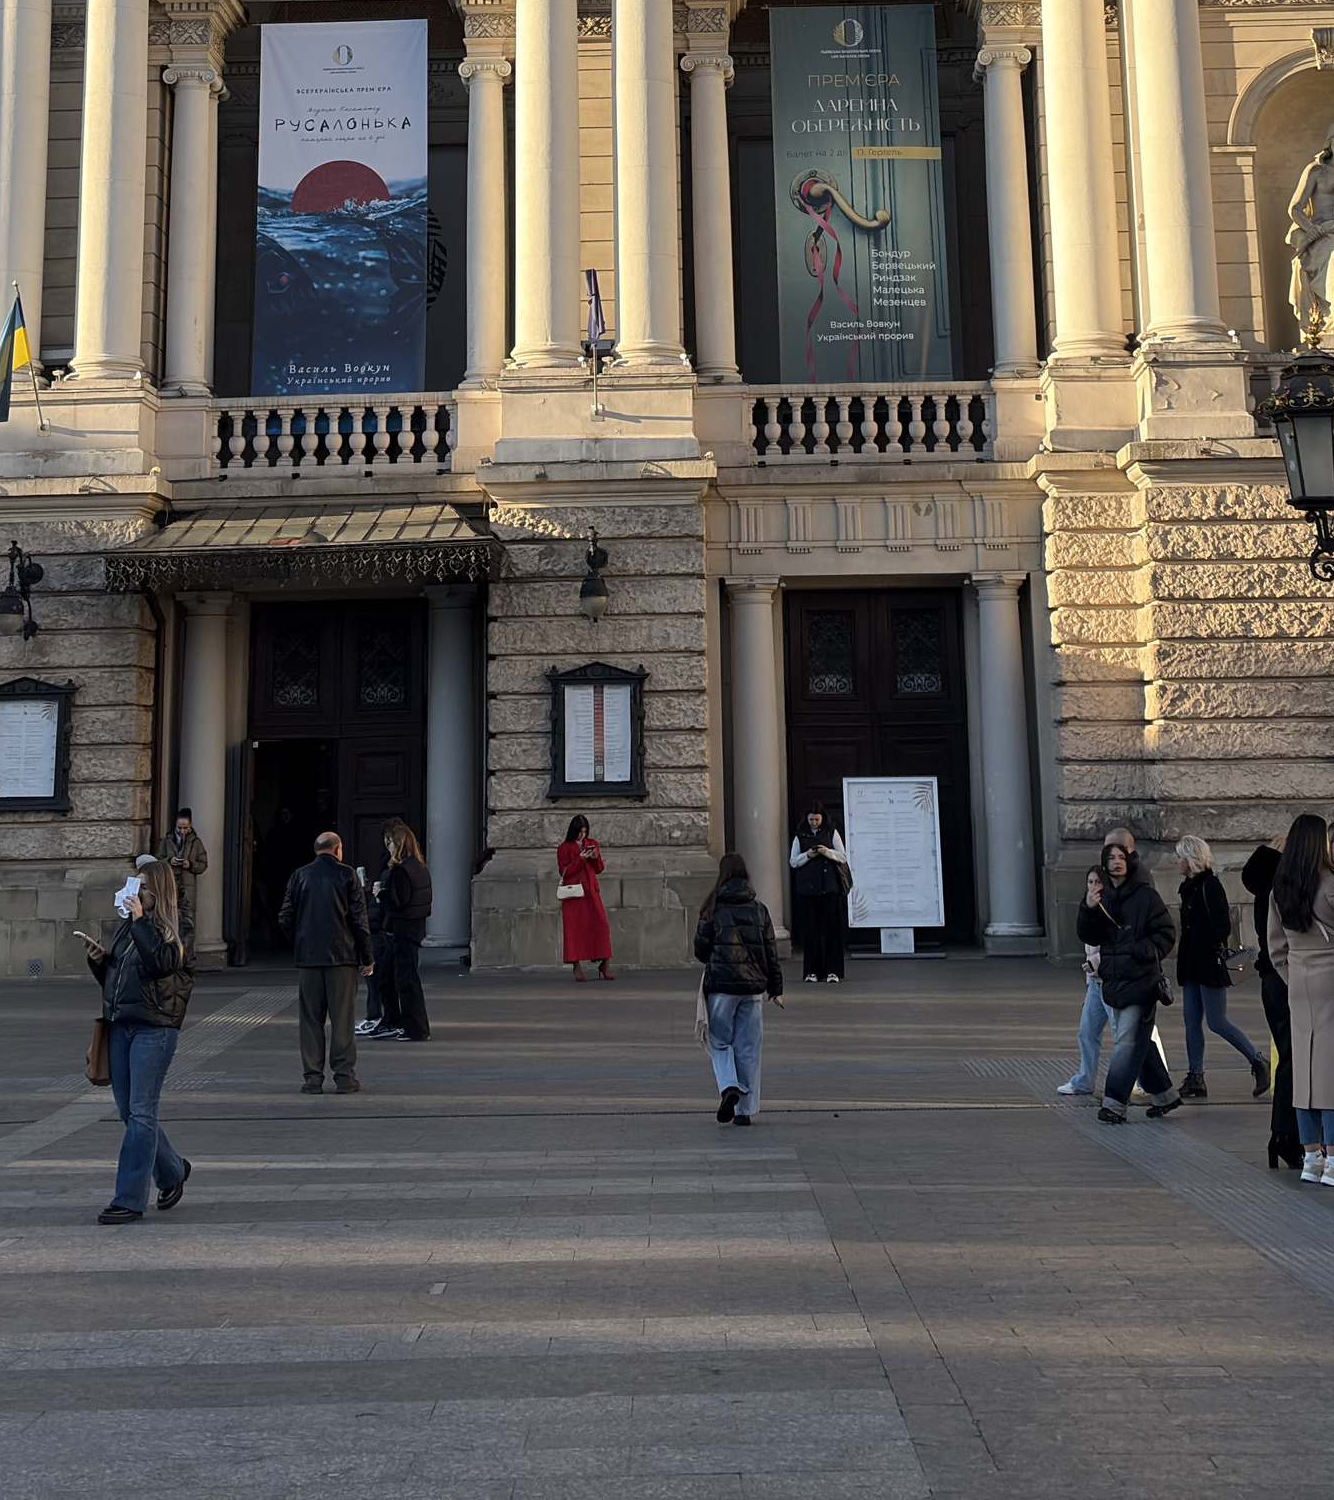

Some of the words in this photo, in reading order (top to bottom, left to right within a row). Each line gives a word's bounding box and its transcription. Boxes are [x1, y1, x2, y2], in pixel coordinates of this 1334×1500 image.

[808, 74, 901, 88] ПРЕМ'ЄРА
[813, 98, 898, 115] ДАРЕМНА
[275, 116, 411, 132] РУСАЛОНЬКА
[791, 118, 921, 133] ОБЕРЕЖНІСТЬ
[829, 149, 835, 157] 2
[868, 149, 903, 157] Гертель
[871, 249, 911, 259] Бондур
[871, 261, 936, 271] Бервецький
[872, 274, 917, 283] Риндзак
[873, 286, 925, 295] Малецька
[873, 299, 926, 307] Мезенцев
[830, 320, 864, 329] Василь
[867, 320, 900, 329] Вовкун
[817, 332, 876, 342] Український
[878, 332, 914, 341] прорив
[289, 364, 337, 374] Василь
[344, 363, 390, 375] Вовкун
[287, 376, 353, 387] Український
[357, 376, 391, 385] прорив
